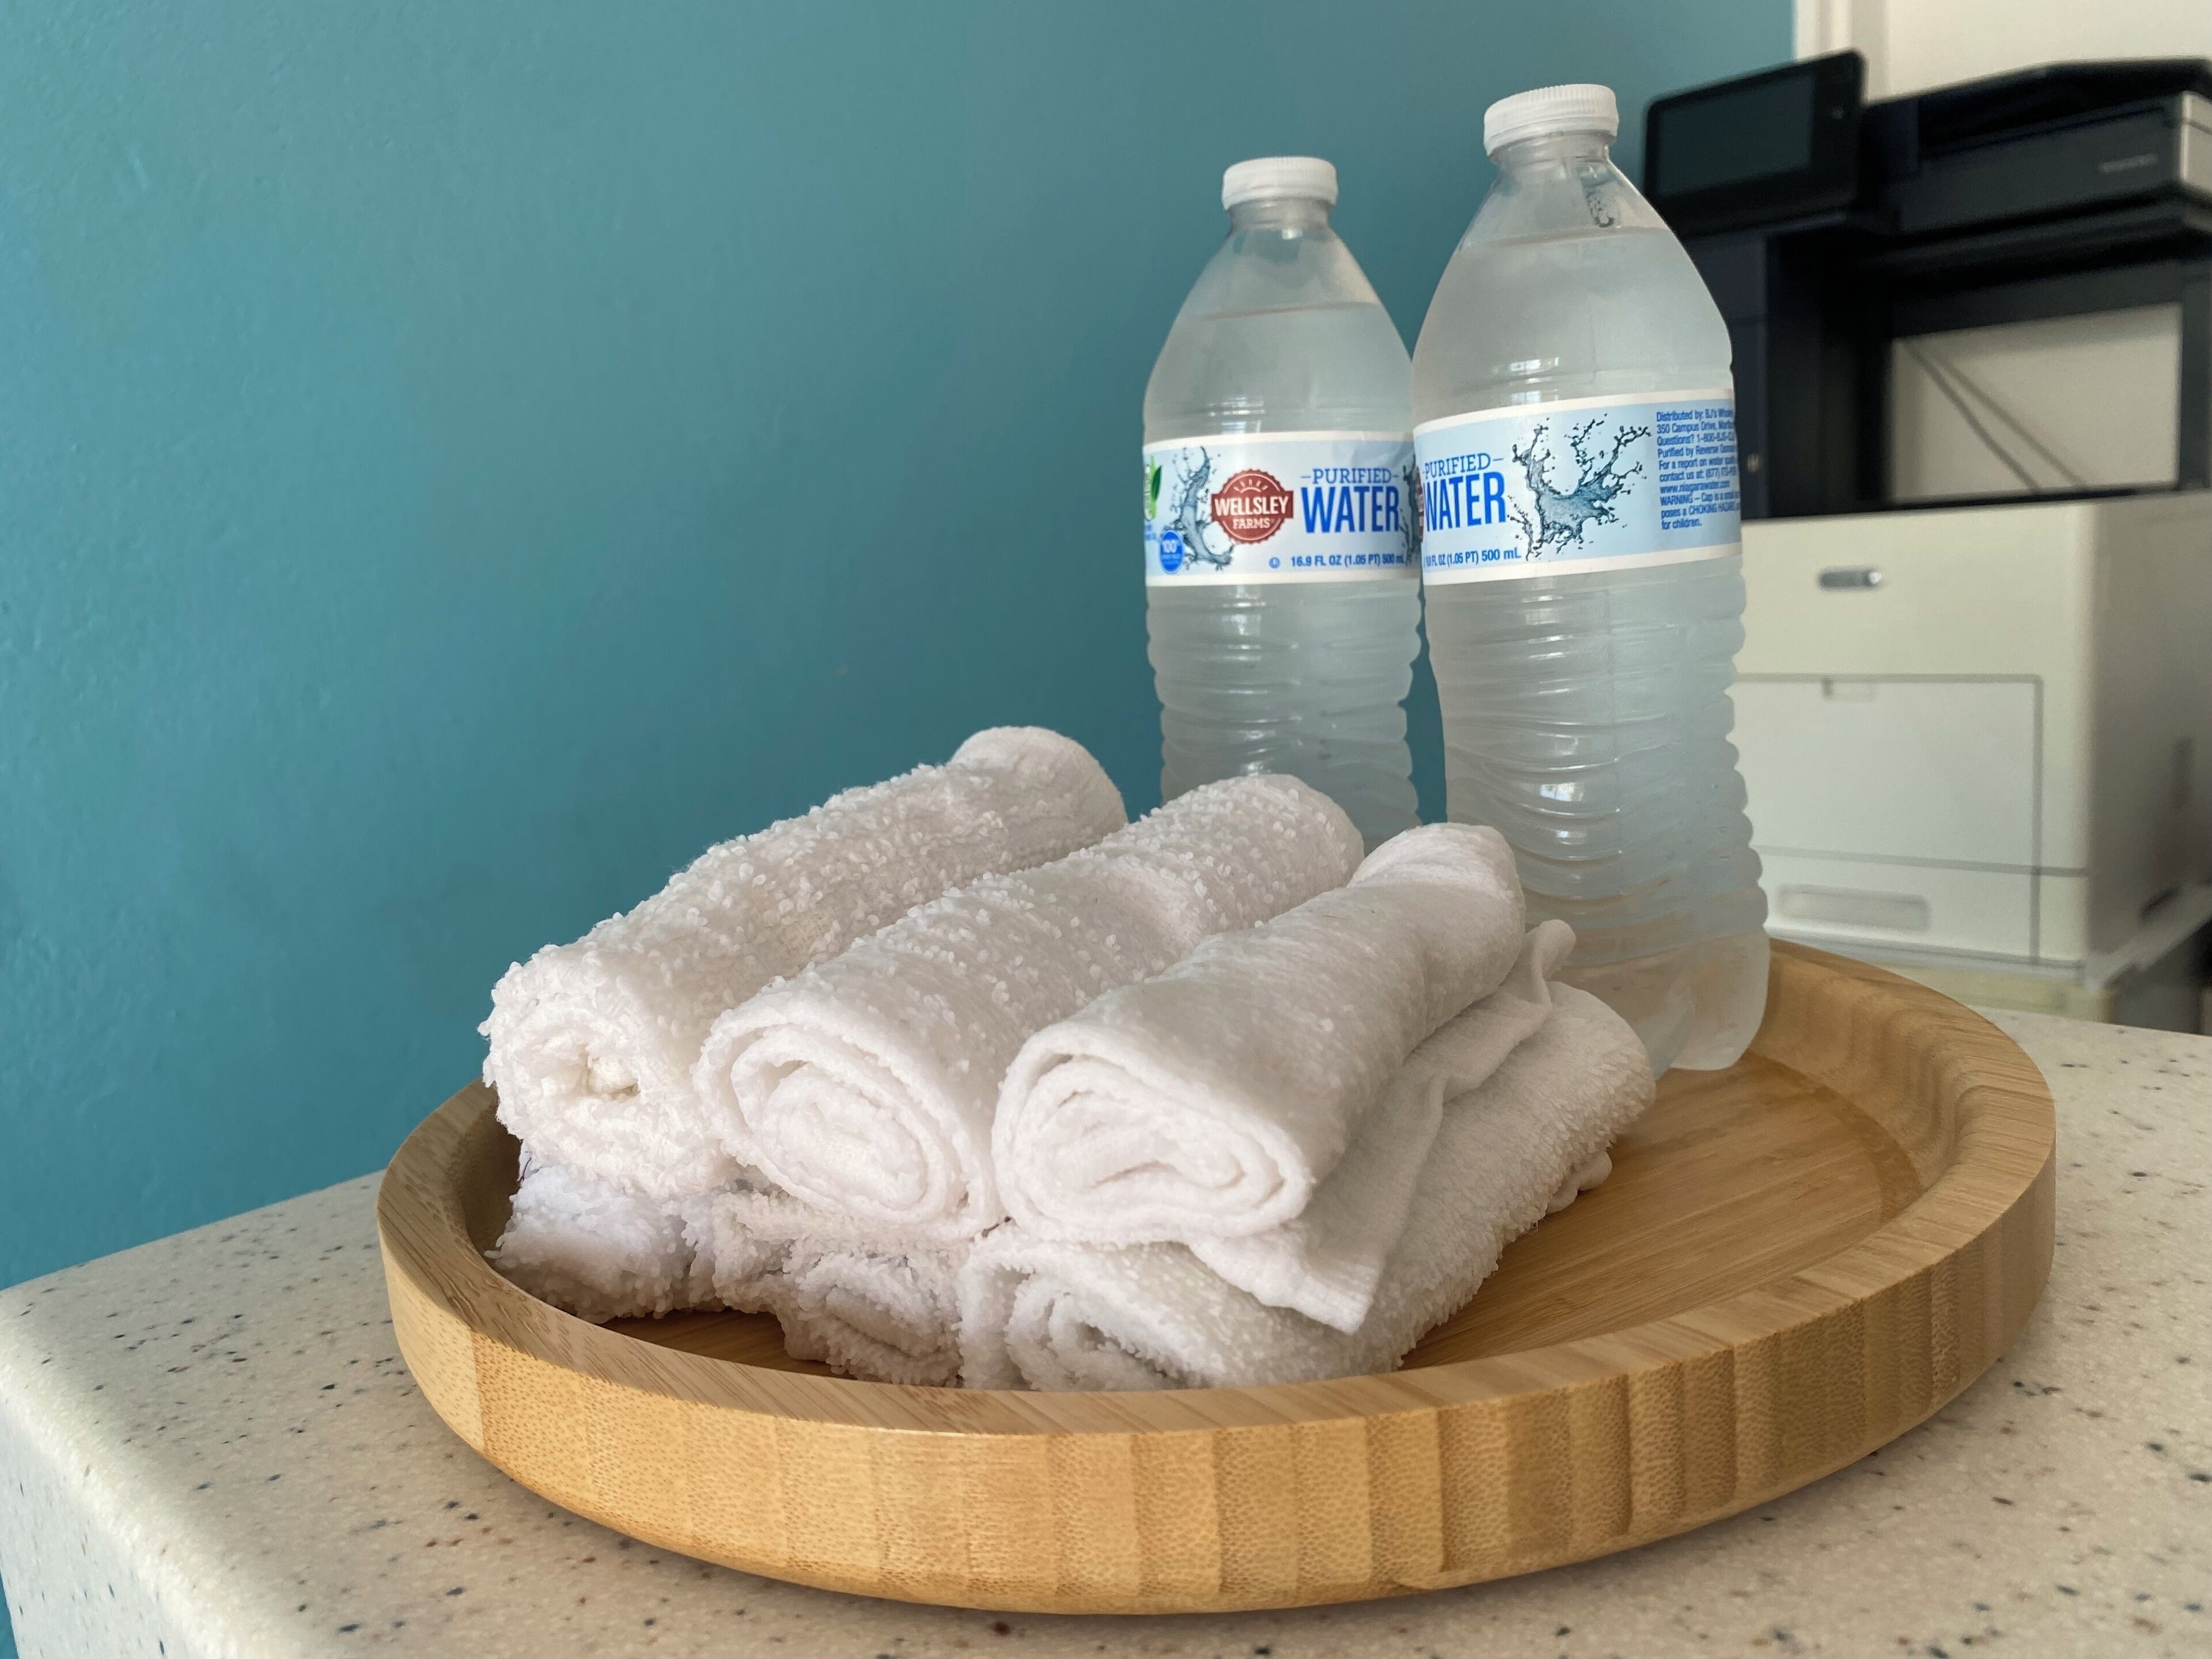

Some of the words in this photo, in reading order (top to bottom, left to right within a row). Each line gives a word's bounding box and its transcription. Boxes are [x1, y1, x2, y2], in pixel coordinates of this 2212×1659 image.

[1656, 410, 1692, 422] Distributed
[1657, 424, 1670, 434] 350
[1672, 423, 1699, 433] Campus
[1657, 434, 1694, 446] Questions?
[1658, 446, 1684, 458] Purified
[1685, 447, 1694, 457] by
[1425, 453, 1491, 479] PURIFIED
[1659, 460, 1670, 470] For
[1678, 459, 1698, 469] report
[1699, 459, 1707, 467] on
[1312, 468, 1392, 484] PURIFIED
[1660, 471, 1685, 482] contact
[1423, 472, 1506, 532] WATER
[1660, 494, 1693, 506] WARNING
[1702, 492, 1713, 503] Cap
[1214, 496, 1289, 516] WELLSLEY
[1301, 486, 1399, 533] WATER
[1661, 509, 1681, 519] poses
[1688, 503, 1718, 515] CHOKING
[1232, 517, 1270, 529] FARMS
[1662, 520, 1671, 530] for
[1672, 518, 1702, 529] children.
[1291, 555, 1312, 567] 16.9
[1315, 555, 1327, 566] FL
[1328, 554, 1342, 566] OZ
[1344, 554, 1366, 567] (1.05
[1368, 554, 1380, 567] PT)
[1438, 554, 1446, 566] OZ
[1447, 552, 1463, 567] (1.05
[1465, 551, 1479, 565] PT)
[1482, 548, 1500, 562] 500
[1503, 547, 1521, 559] mL
